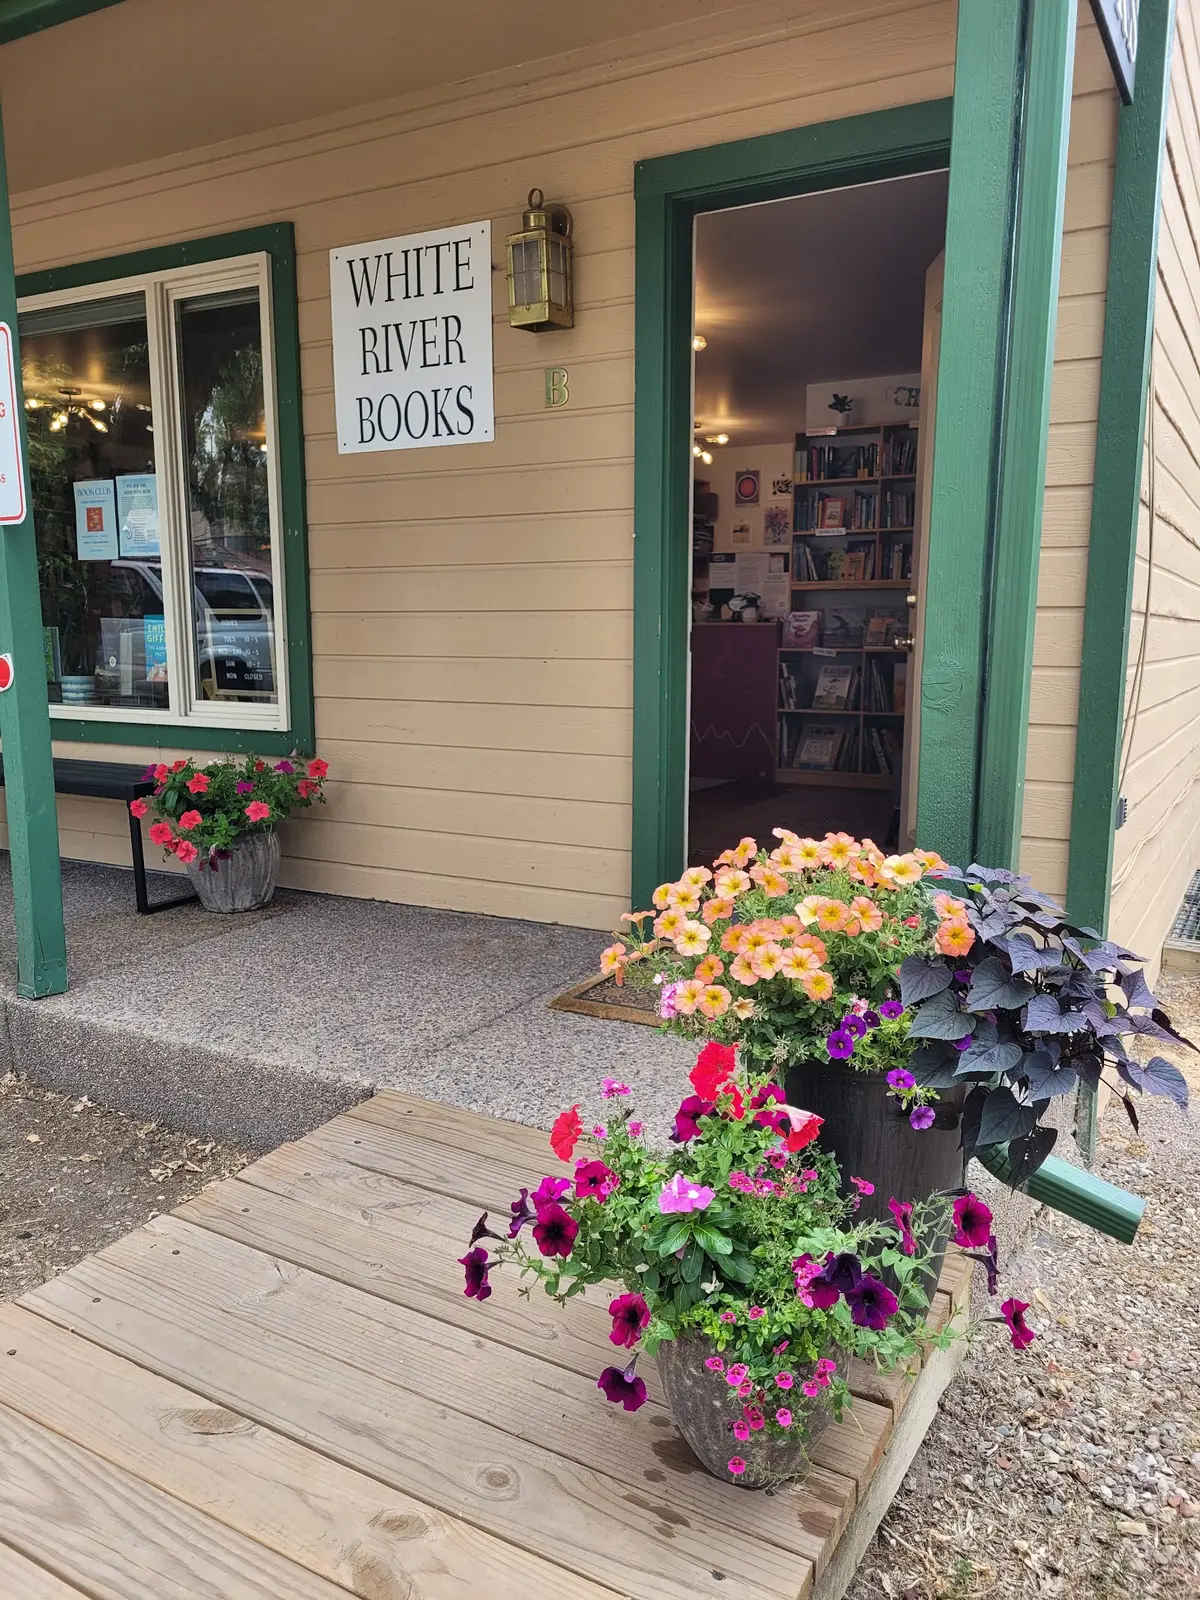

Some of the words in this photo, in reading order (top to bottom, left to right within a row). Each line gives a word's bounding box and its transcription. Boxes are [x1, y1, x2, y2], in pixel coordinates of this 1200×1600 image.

[346, 237, 474, 308] WHITE
[359, 315, 466, 375] RIVER
[356, 385, 474, 443] BOOKS
[545, 367, 569, 408] B
[77, 488, 95, 497] BOOK
[95, 487, 112, 496] CLUB
